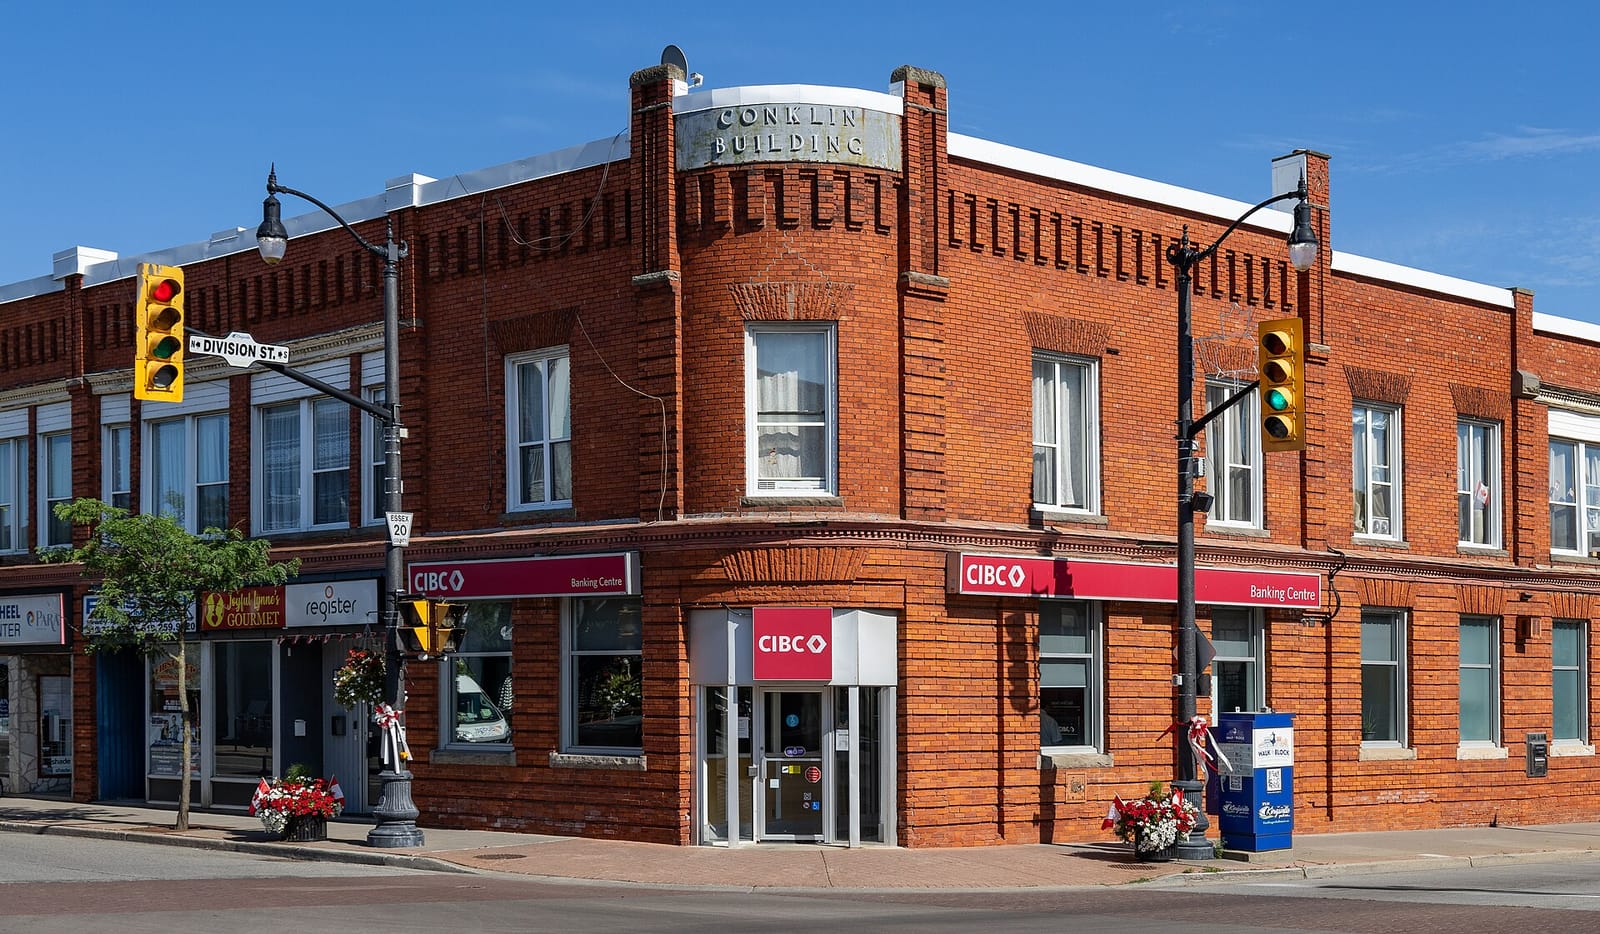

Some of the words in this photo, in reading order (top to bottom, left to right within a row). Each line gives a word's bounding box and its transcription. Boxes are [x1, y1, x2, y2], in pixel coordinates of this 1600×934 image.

[719, 107, 856, 127] CONKLIN
[715, 134, 863, 155] BUILDING
[191, 340, 195, 348] N
[203, 339, 256, 358] DIVISION
[259, 346, 276, 360] ST.
[284, 350, 288, 359] S
[390, 514, 409, 522] ESSEX
[393, 524, 407, 536] 20
[414, 571, 448, 592] CIBC
[571, 577, 598, 588] Banking
[599, 576, 623, 587] Centre
[966, 564, 1007, 586] CIBC
[1250, 584, 1285, 602] Banking
[1287, 586, 1316, 601] Centre
[306, 597, 357, 622] register
[227, 611, 280, 627] GOURMET
[758, 635, 805, 653] CIBC
[1274, 749, 1290, 757] BLOCK
